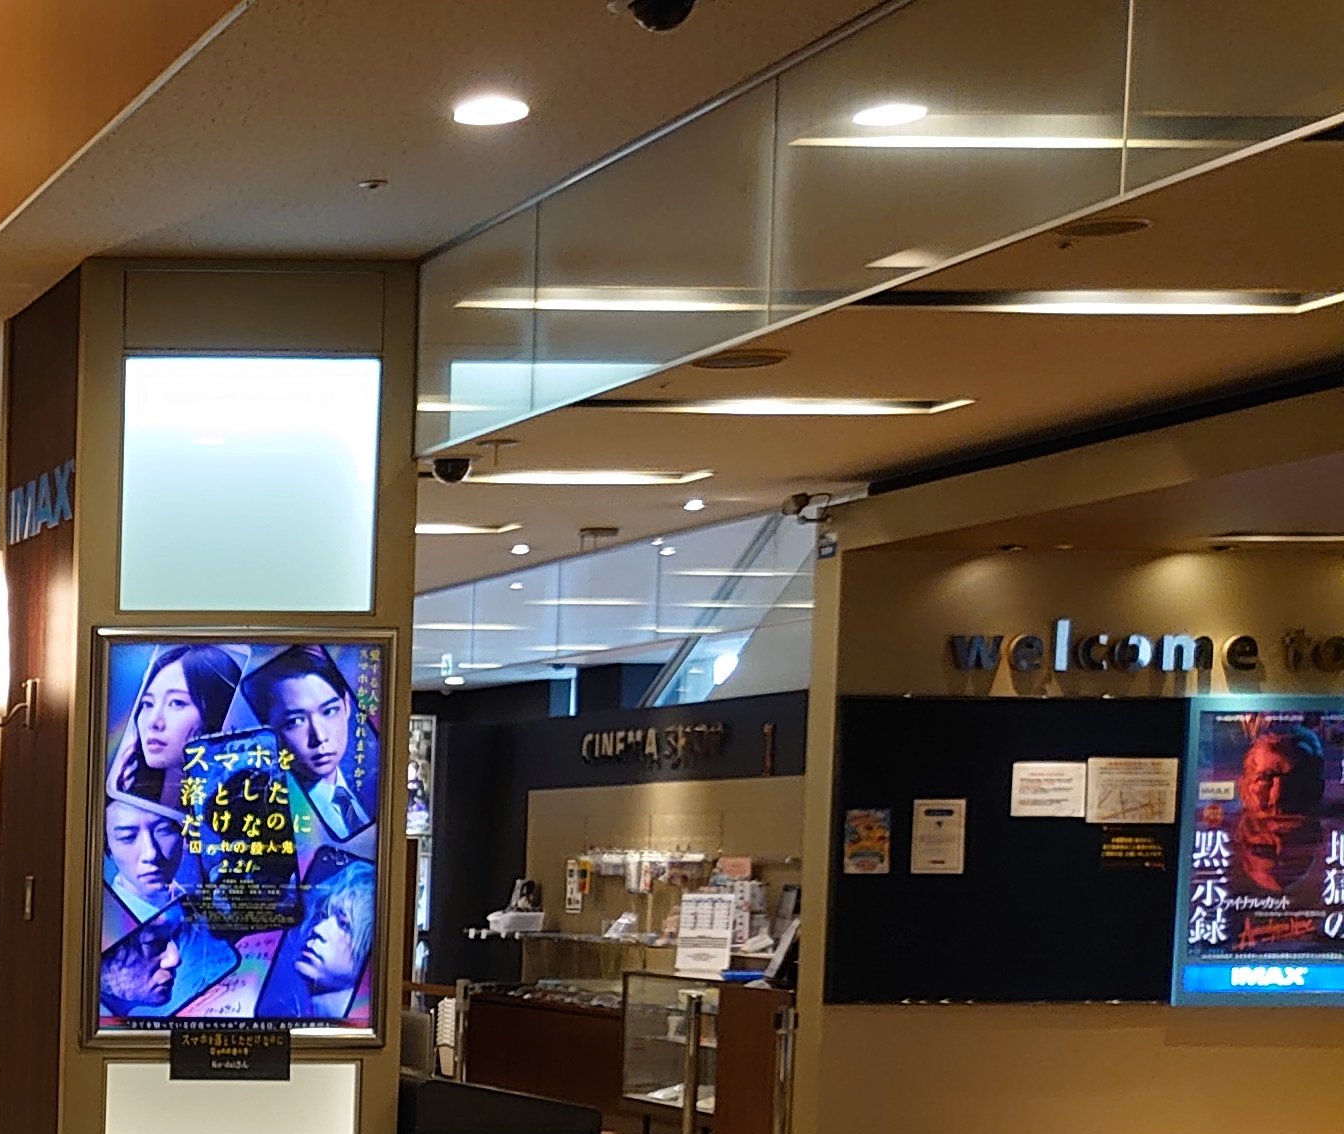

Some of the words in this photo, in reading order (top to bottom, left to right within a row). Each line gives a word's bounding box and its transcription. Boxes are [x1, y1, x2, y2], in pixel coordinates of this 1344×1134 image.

[8, 459, 75, 545] IMAX
[951, 618, 1258, 671] welcome
[183, 745, 295, 771] スマホを
[582, 728, 659, 762] CINEMA
[180, 777, 289, 806] 落とした
[181, 810, 311, 838] だけなのに
[1188, 830, 1230, 944] 黙示録
[1231, 967, 1309, 986] IMAX
